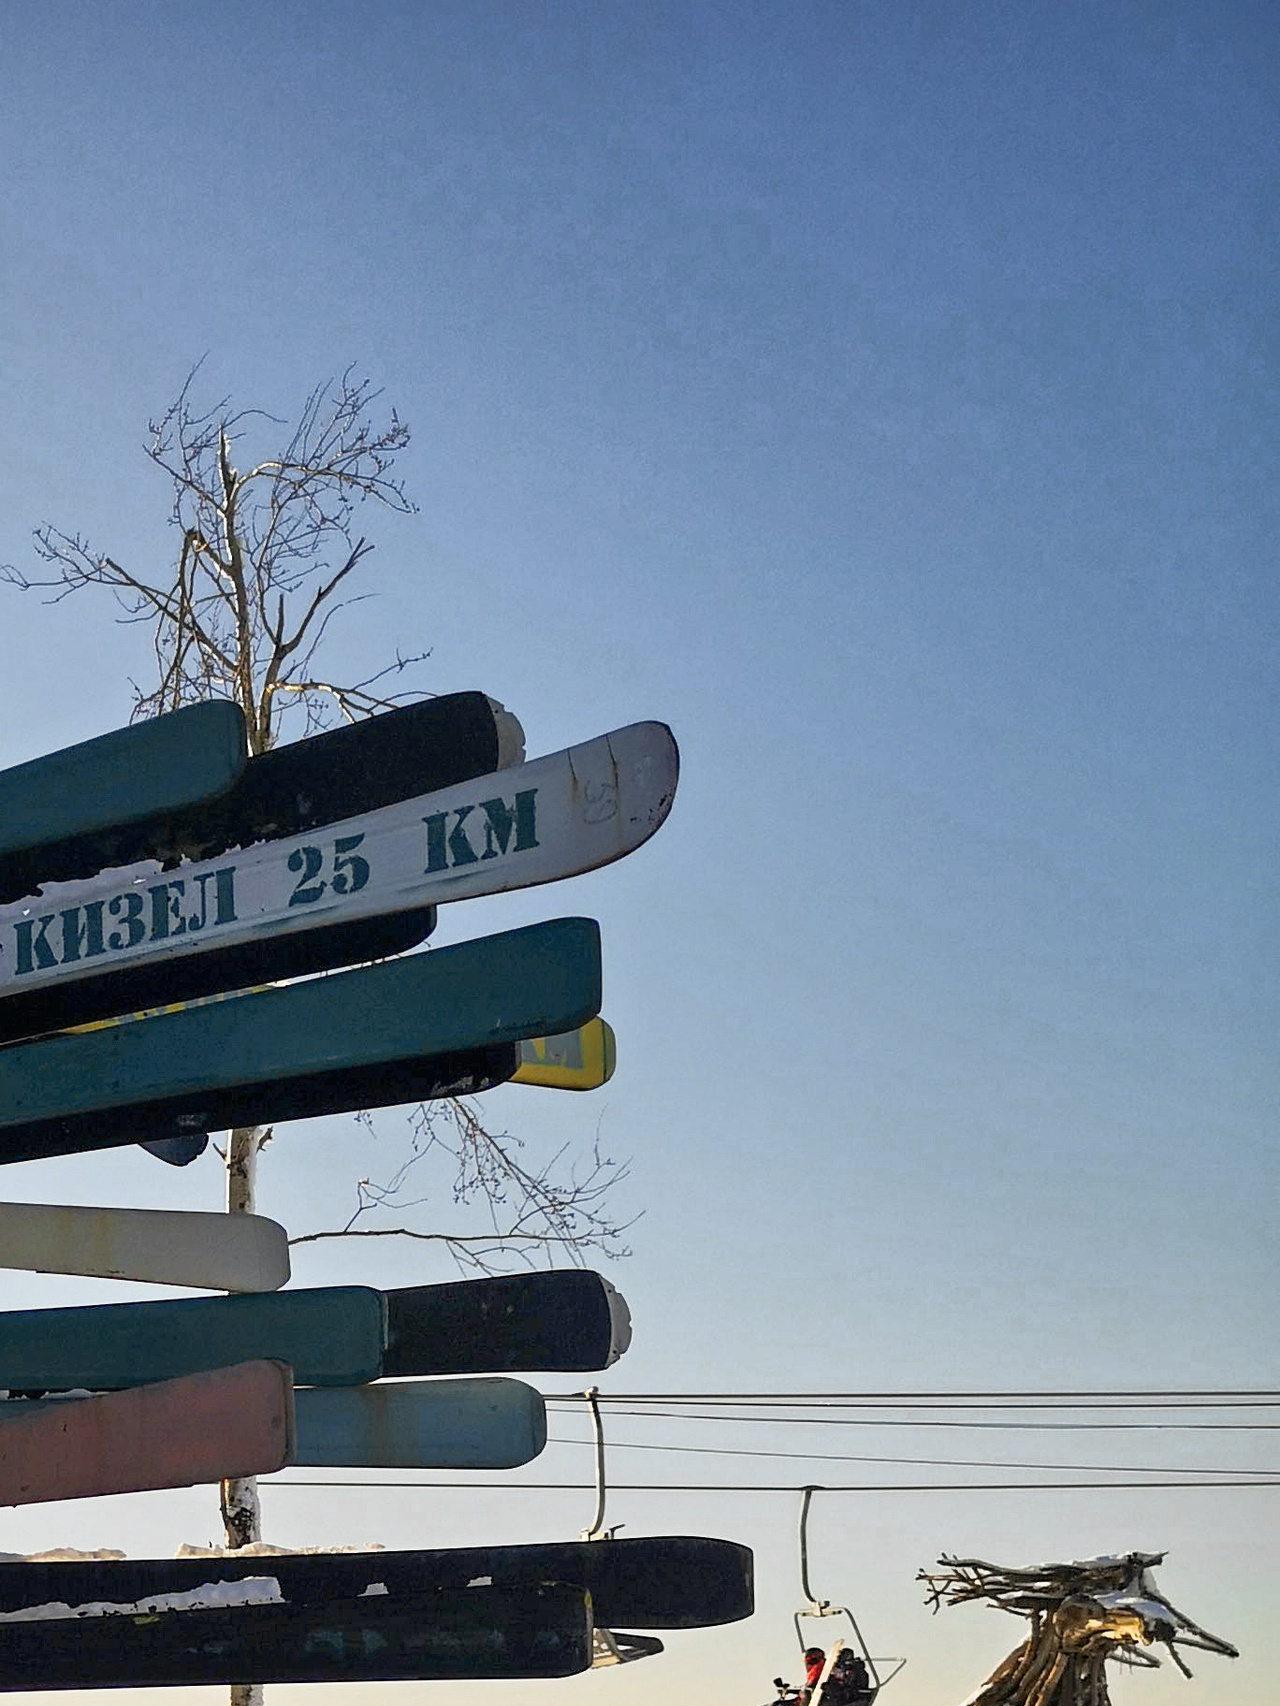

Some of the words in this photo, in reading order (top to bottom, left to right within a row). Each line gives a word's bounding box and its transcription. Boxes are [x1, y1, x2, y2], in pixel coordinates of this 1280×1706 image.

[13, 866, 238, 976] КИЗЕЛ
[287, 832, 371, 907] 25
[421, 788, 540, 875] КМ
